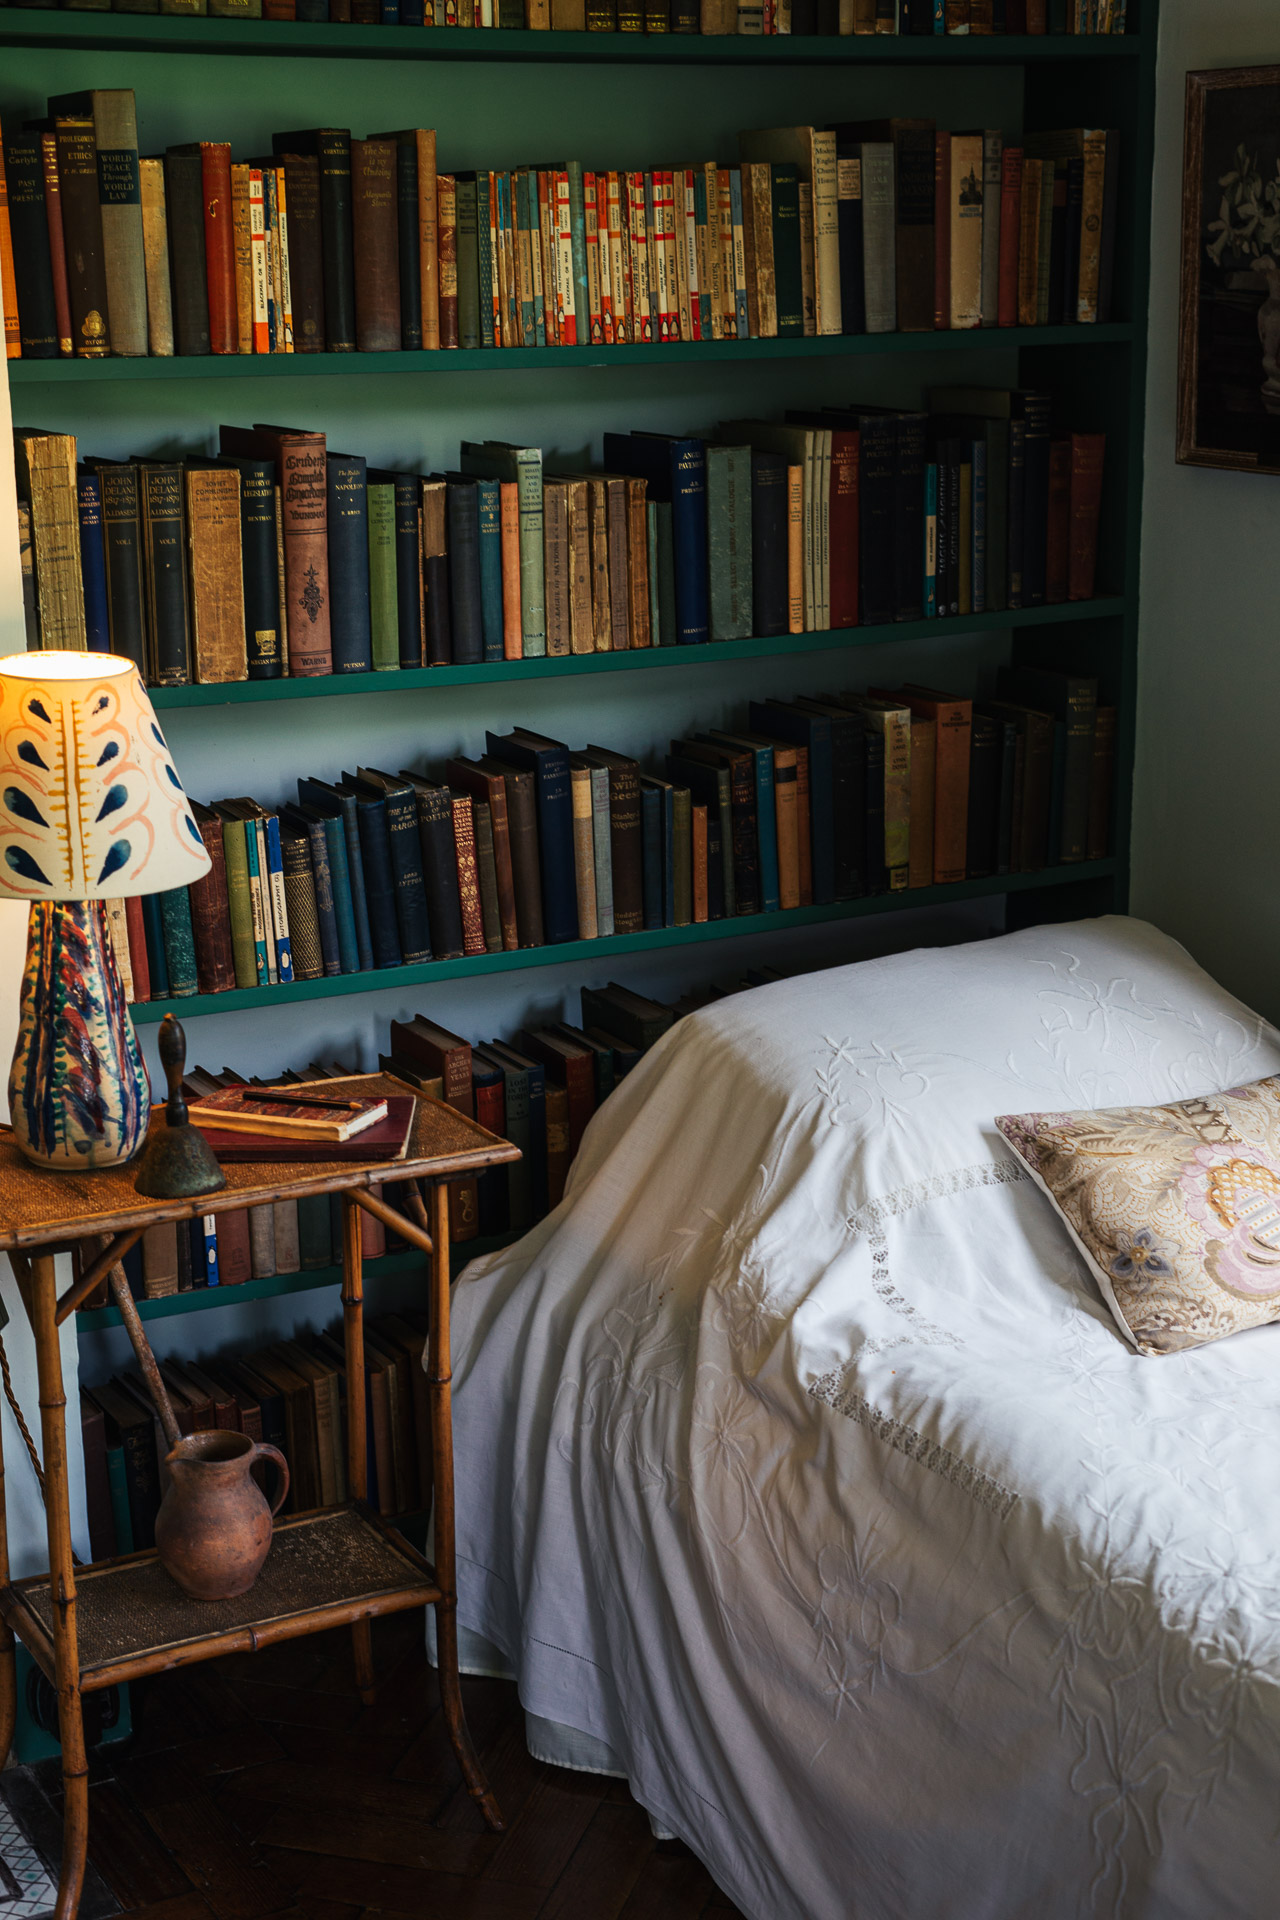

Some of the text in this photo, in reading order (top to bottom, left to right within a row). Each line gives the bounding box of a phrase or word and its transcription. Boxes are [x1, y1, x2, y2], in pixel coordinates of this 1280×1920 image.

[9, 147, 36, 155] Thomas
[363, 145, 391, 155] The Sun
[67, 152, 93, 160] ETHICS
[100, 154, 132, 163] WORLD
[8, 156, 38, 166] Carlyle
[103, 164, 131, 172] PEACE
[103, 173, 133, 182] Through
[362, 167, 391, 179] Undoing
[17, 179, 36, 187] PAST
[104, 183, 134, 192] WORLD
[11, 194, 44, 202] PRESENT
[109, 192, 127, 201] LAW
[707, 168, 720, 300] Fireman Flower Sansom
[107, 477, 132, 486] JOHN
[151, 476, 176, 485] JOHN
[347, 476, 353, 484] of
[105, 487, 135, 496] DELANE
[149, 486, 180, 495] DELANE
[289, 510, 325, 520] YOUNGMAN
[301, 657, 327, 666] WARNE
[619, 773, 633, 781] The
[612, 780, 637, 790] Wild
[610, 791, 640, 800] Geese
[420, 812, 451, 823] POETRY
[276, 885, 285, 937] AUTOBIOGRAPHY
[450, 1072, 470, 1081] YEARS
[510, 1078, 526, 1086] LOST
